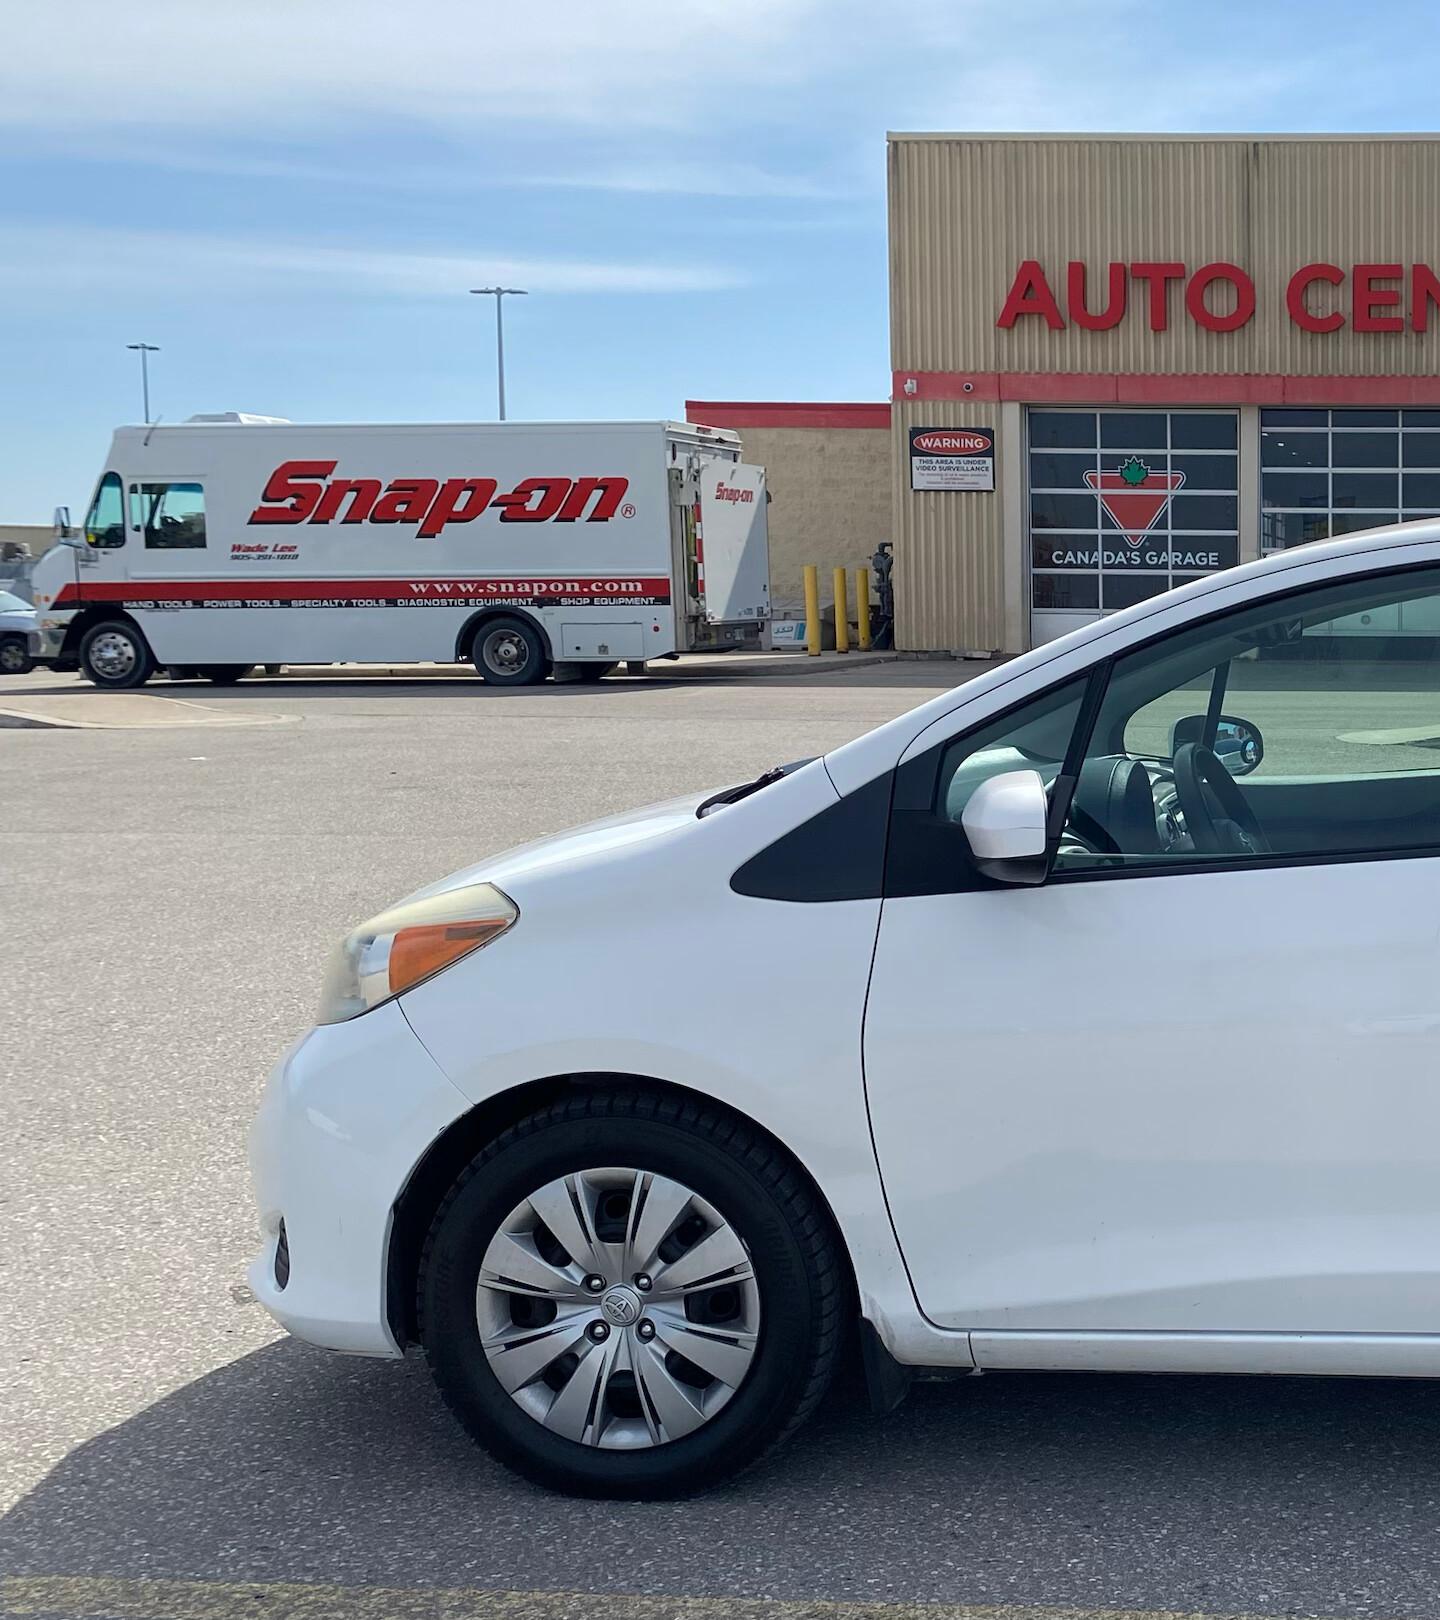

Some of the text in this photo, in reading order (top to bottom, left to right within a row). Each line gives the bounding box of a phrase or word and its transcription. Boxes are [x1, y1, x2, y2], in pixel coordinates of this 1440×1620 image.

[996, 261, 1256, 332] AUTO
[920, 438, 984, 449] WARNING
[230, 544, 298, 553] Wade Lee
[1052, 551, 1219, 566] CANADA'S GARAGE
[409, 581, 643, 596] www.snapon.com
[122, 600, 155, 609] HAND
[203, 600, 242, 608] POWER
[291, 599, 347, 608] SPECIALTY
[397, 599, 466, 607] DIAGNOSTIC
[560, 597, 591, 606] SHOP
